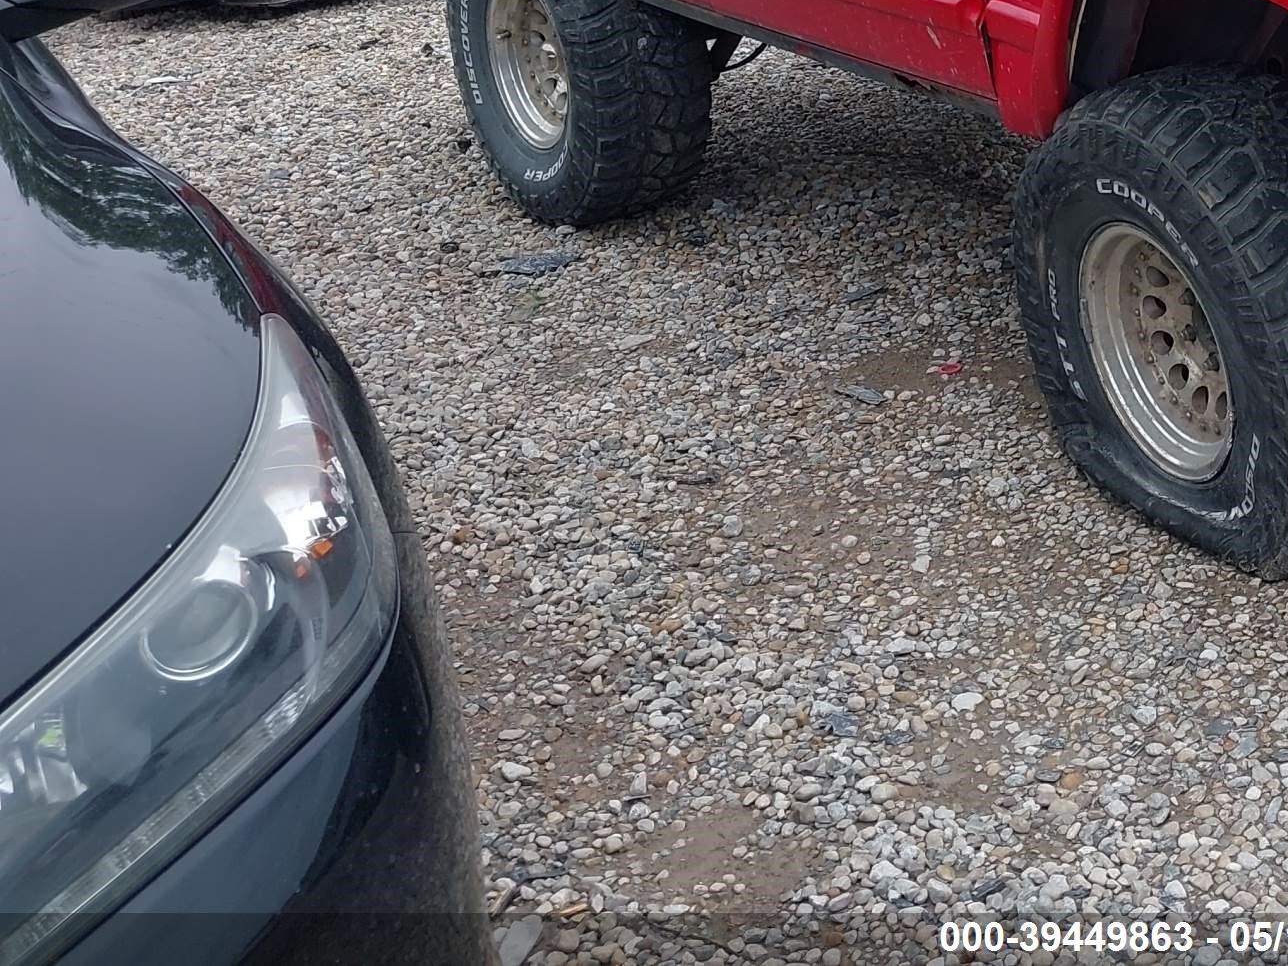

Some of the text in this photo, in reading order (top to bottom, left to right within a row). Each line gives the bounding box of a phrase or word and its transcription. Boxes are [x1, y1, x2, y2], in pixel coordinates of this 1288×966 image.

[523, 139, 568, 182] COOPER
[1096, 178, 1199, 267] COOPER
[1047, 268, 1061, 322] PRO
